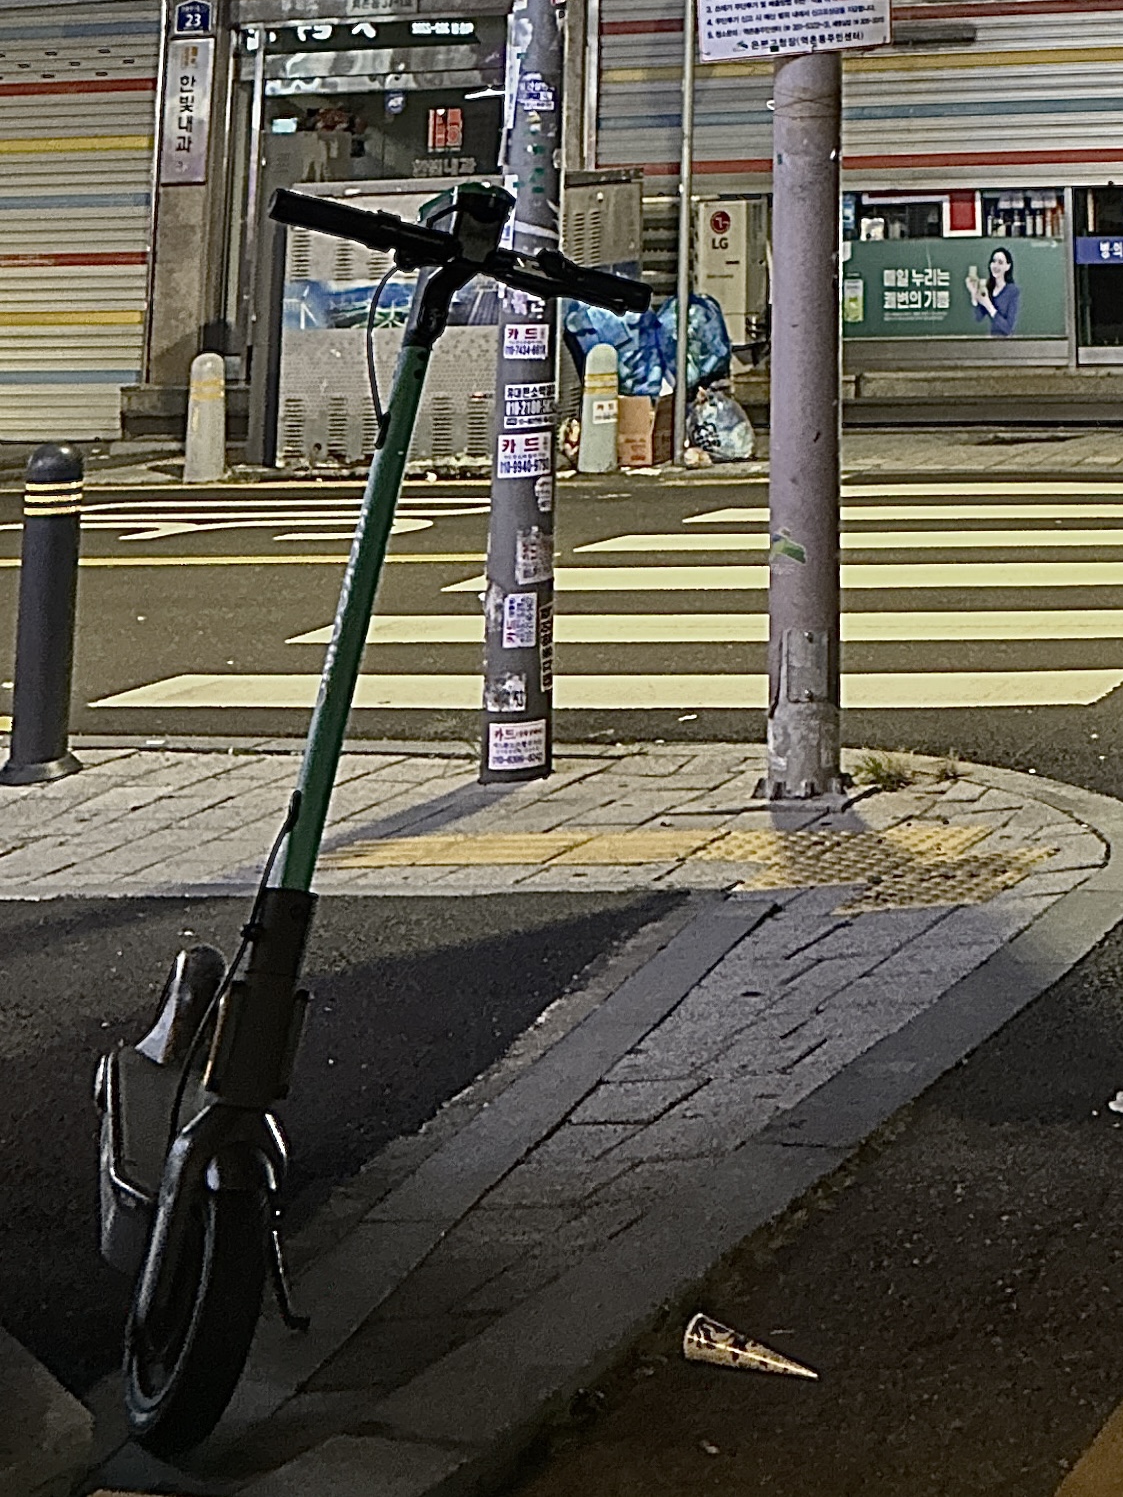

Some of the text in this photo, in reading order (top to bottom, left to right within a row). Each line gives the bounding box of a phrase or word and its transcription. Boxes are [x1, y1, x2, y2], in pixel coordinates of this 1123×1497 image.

[185, 14, 202, 28] 23
[175, 75, 196, 153] 한빛내과
[712, 238, 729, 250] LG
[911, 268, 951, 287] 누리는
[502, 437, 540, 453] 카드
